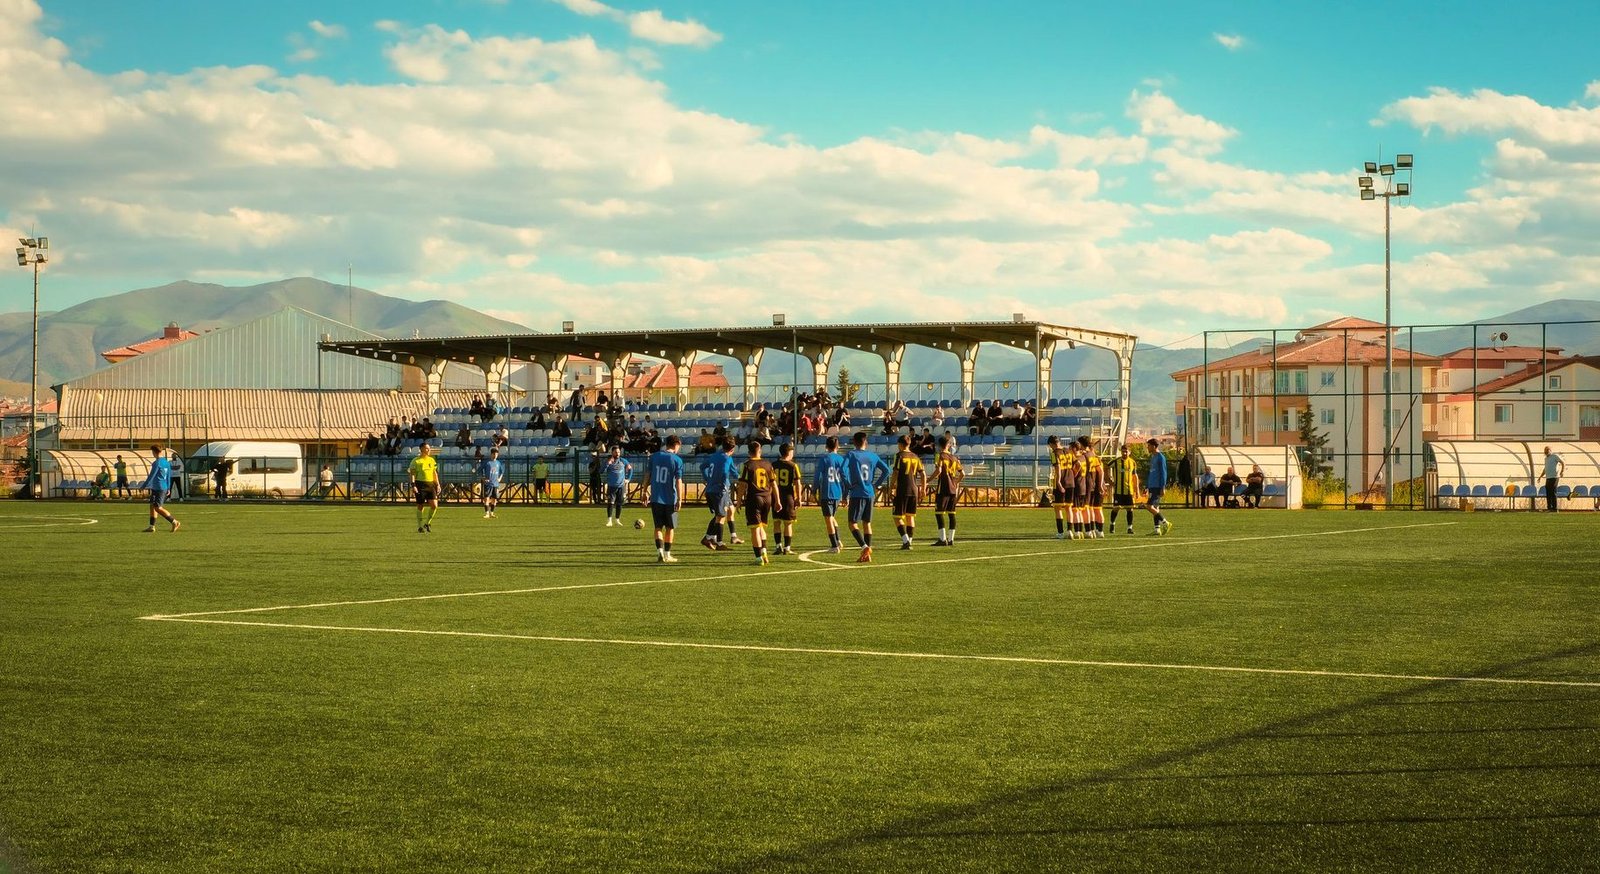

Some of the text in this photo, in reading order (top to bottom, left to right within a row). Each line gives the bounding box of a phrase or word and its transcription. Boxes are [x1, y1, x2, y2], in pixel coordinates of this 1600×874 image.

[656, 465, 668, 483] 10
[861, 464, 869, 481] 6
[903, 457, 919, 476] 77
[756, 468, 767, 489] 6
[775, 468, 790, 486] 19
